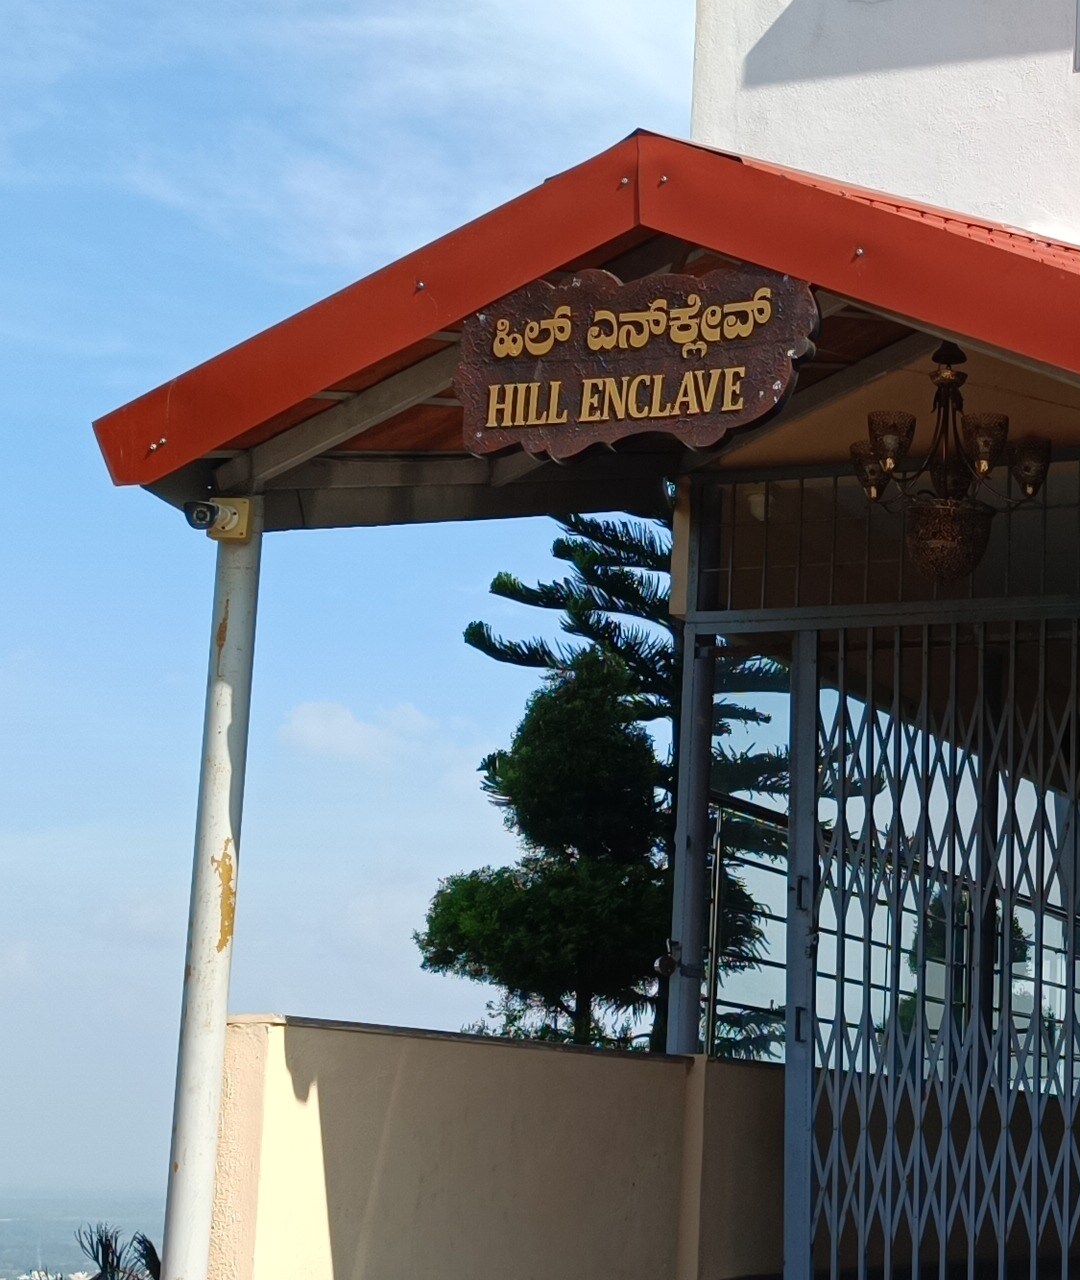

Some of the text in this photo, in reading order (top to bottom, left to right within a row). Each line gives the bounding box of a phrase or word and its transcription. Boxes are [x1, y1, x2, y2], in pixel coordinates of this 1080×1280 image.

[493, 305, 572, 358] ಹಿಲ್
[485, 366, 746, 428] HILL ENCLAVE
